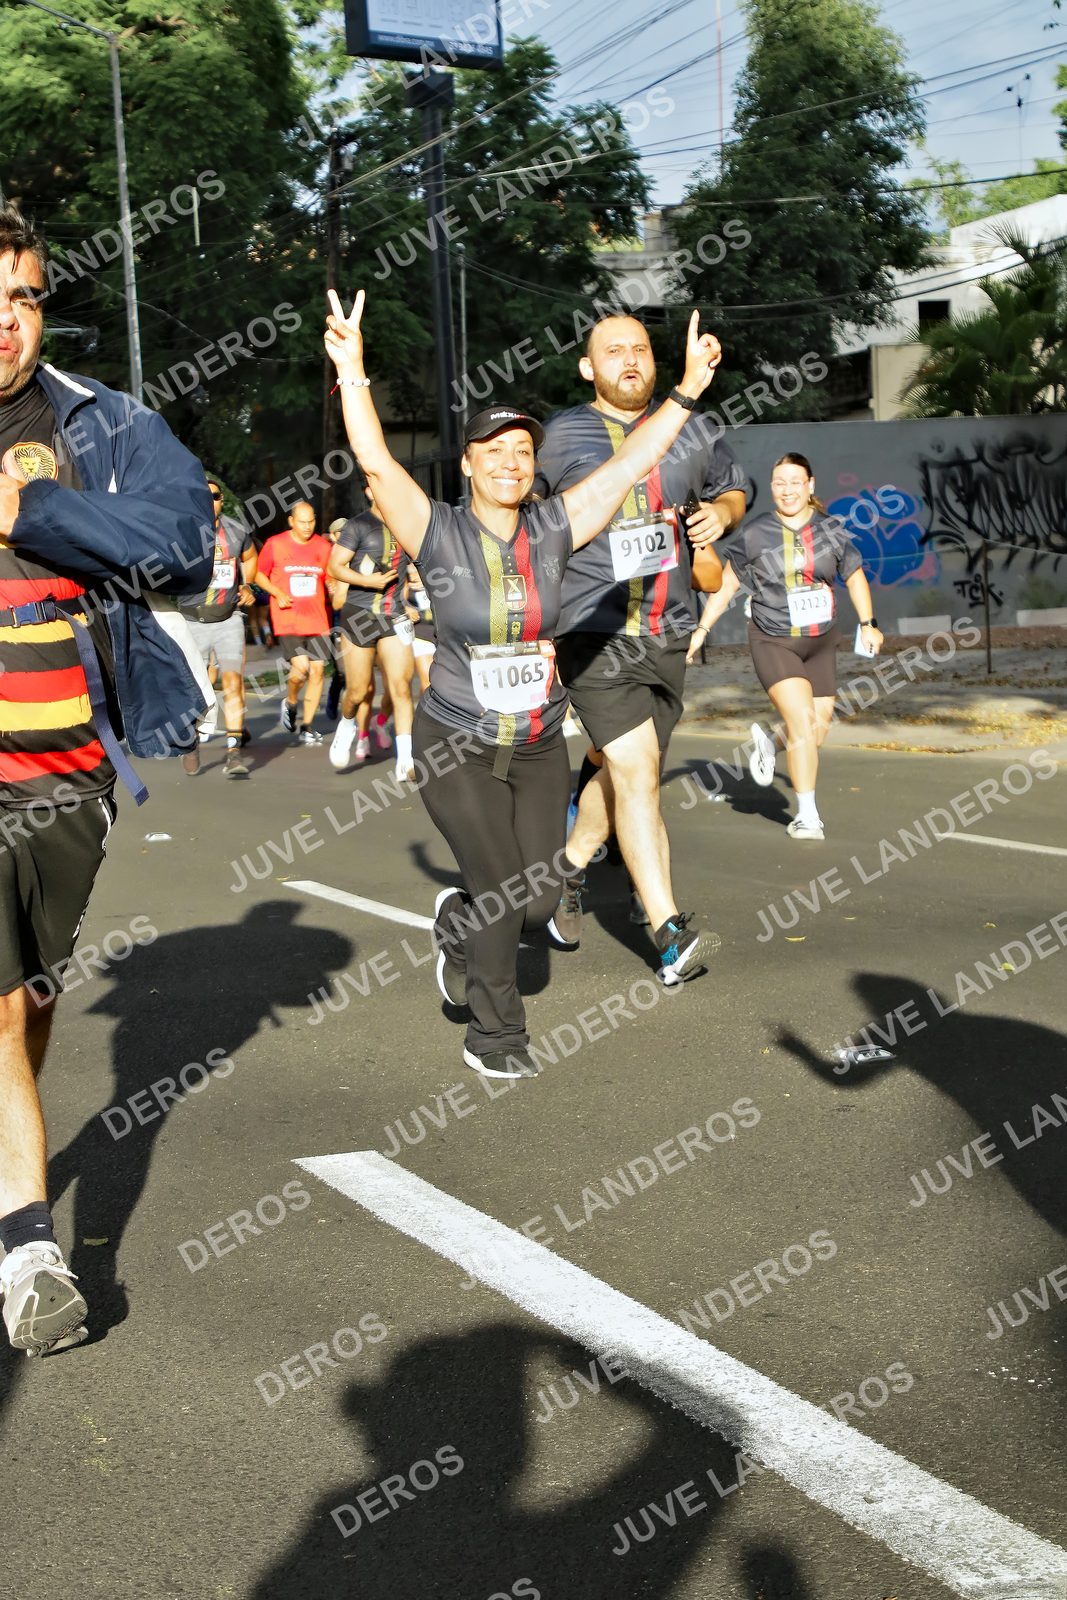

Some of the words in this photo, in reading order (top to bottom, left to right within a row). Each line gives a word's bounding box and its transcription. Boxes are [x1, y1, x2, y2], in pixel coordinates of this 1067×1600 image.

[620, 531, 667, 558] 9102
[794, 596, 828, 612] 12123
[477, 662, 545, 689] 11065
